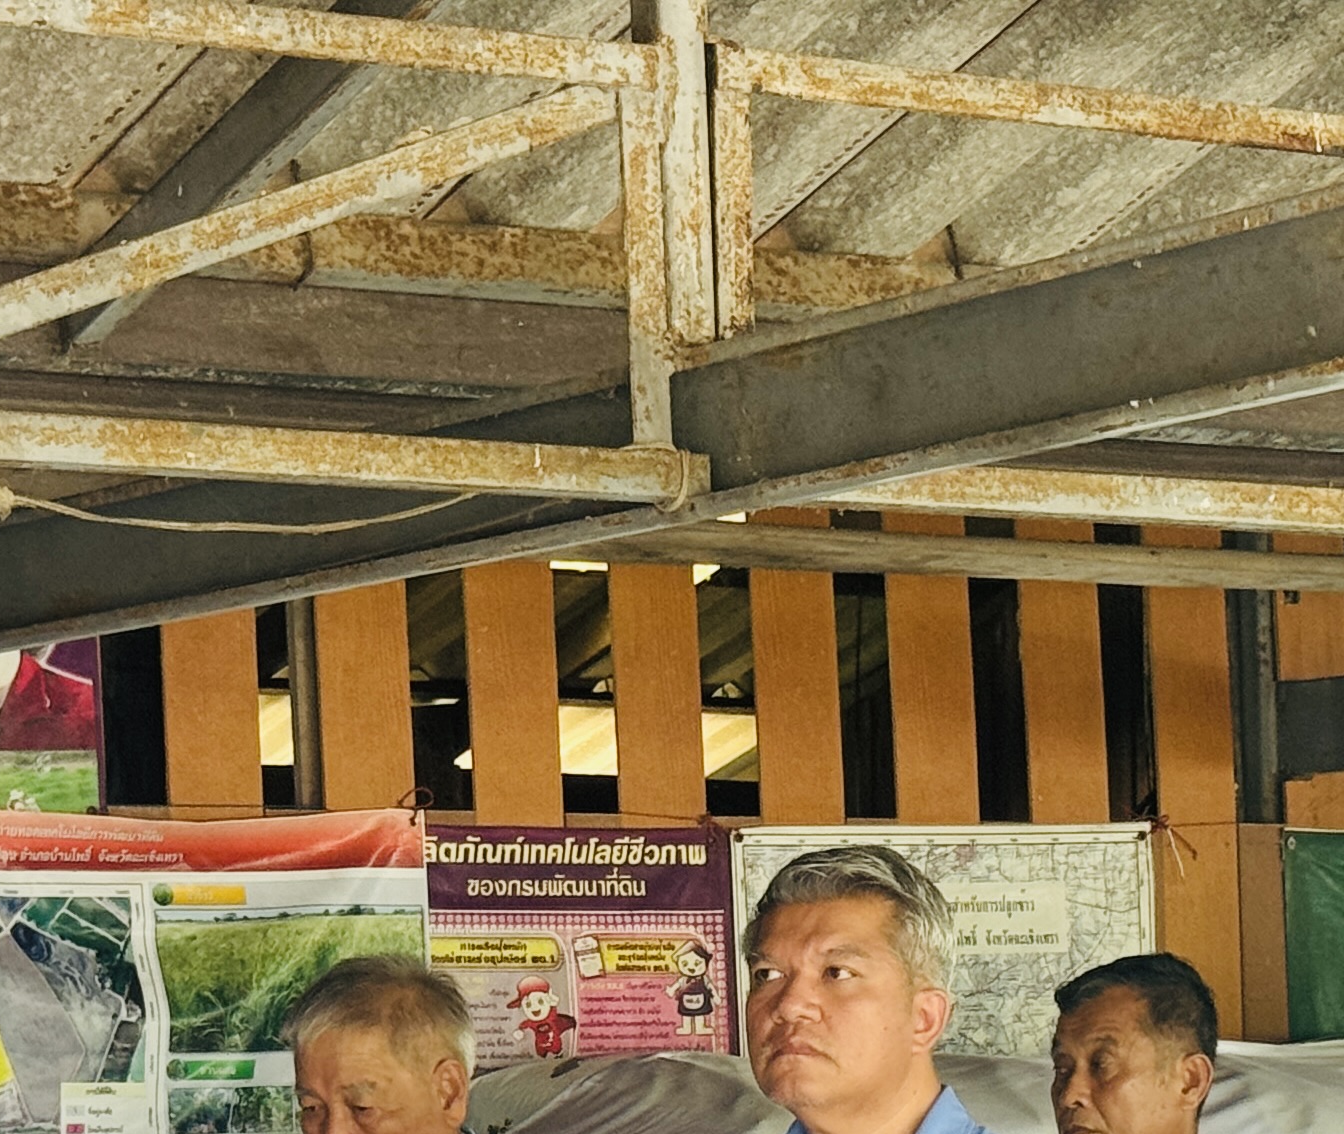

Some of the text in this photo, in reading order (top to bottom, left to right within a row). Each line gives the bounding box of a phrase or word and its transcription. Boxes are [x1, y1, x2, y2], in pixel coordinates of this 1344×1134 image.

[425, 835, 707, 866] ลิตภัณฑ์เทคโนโลยีชีวภาพ
[467, 867, 647, 897] ของกรมพัฒนาที่ดิน
